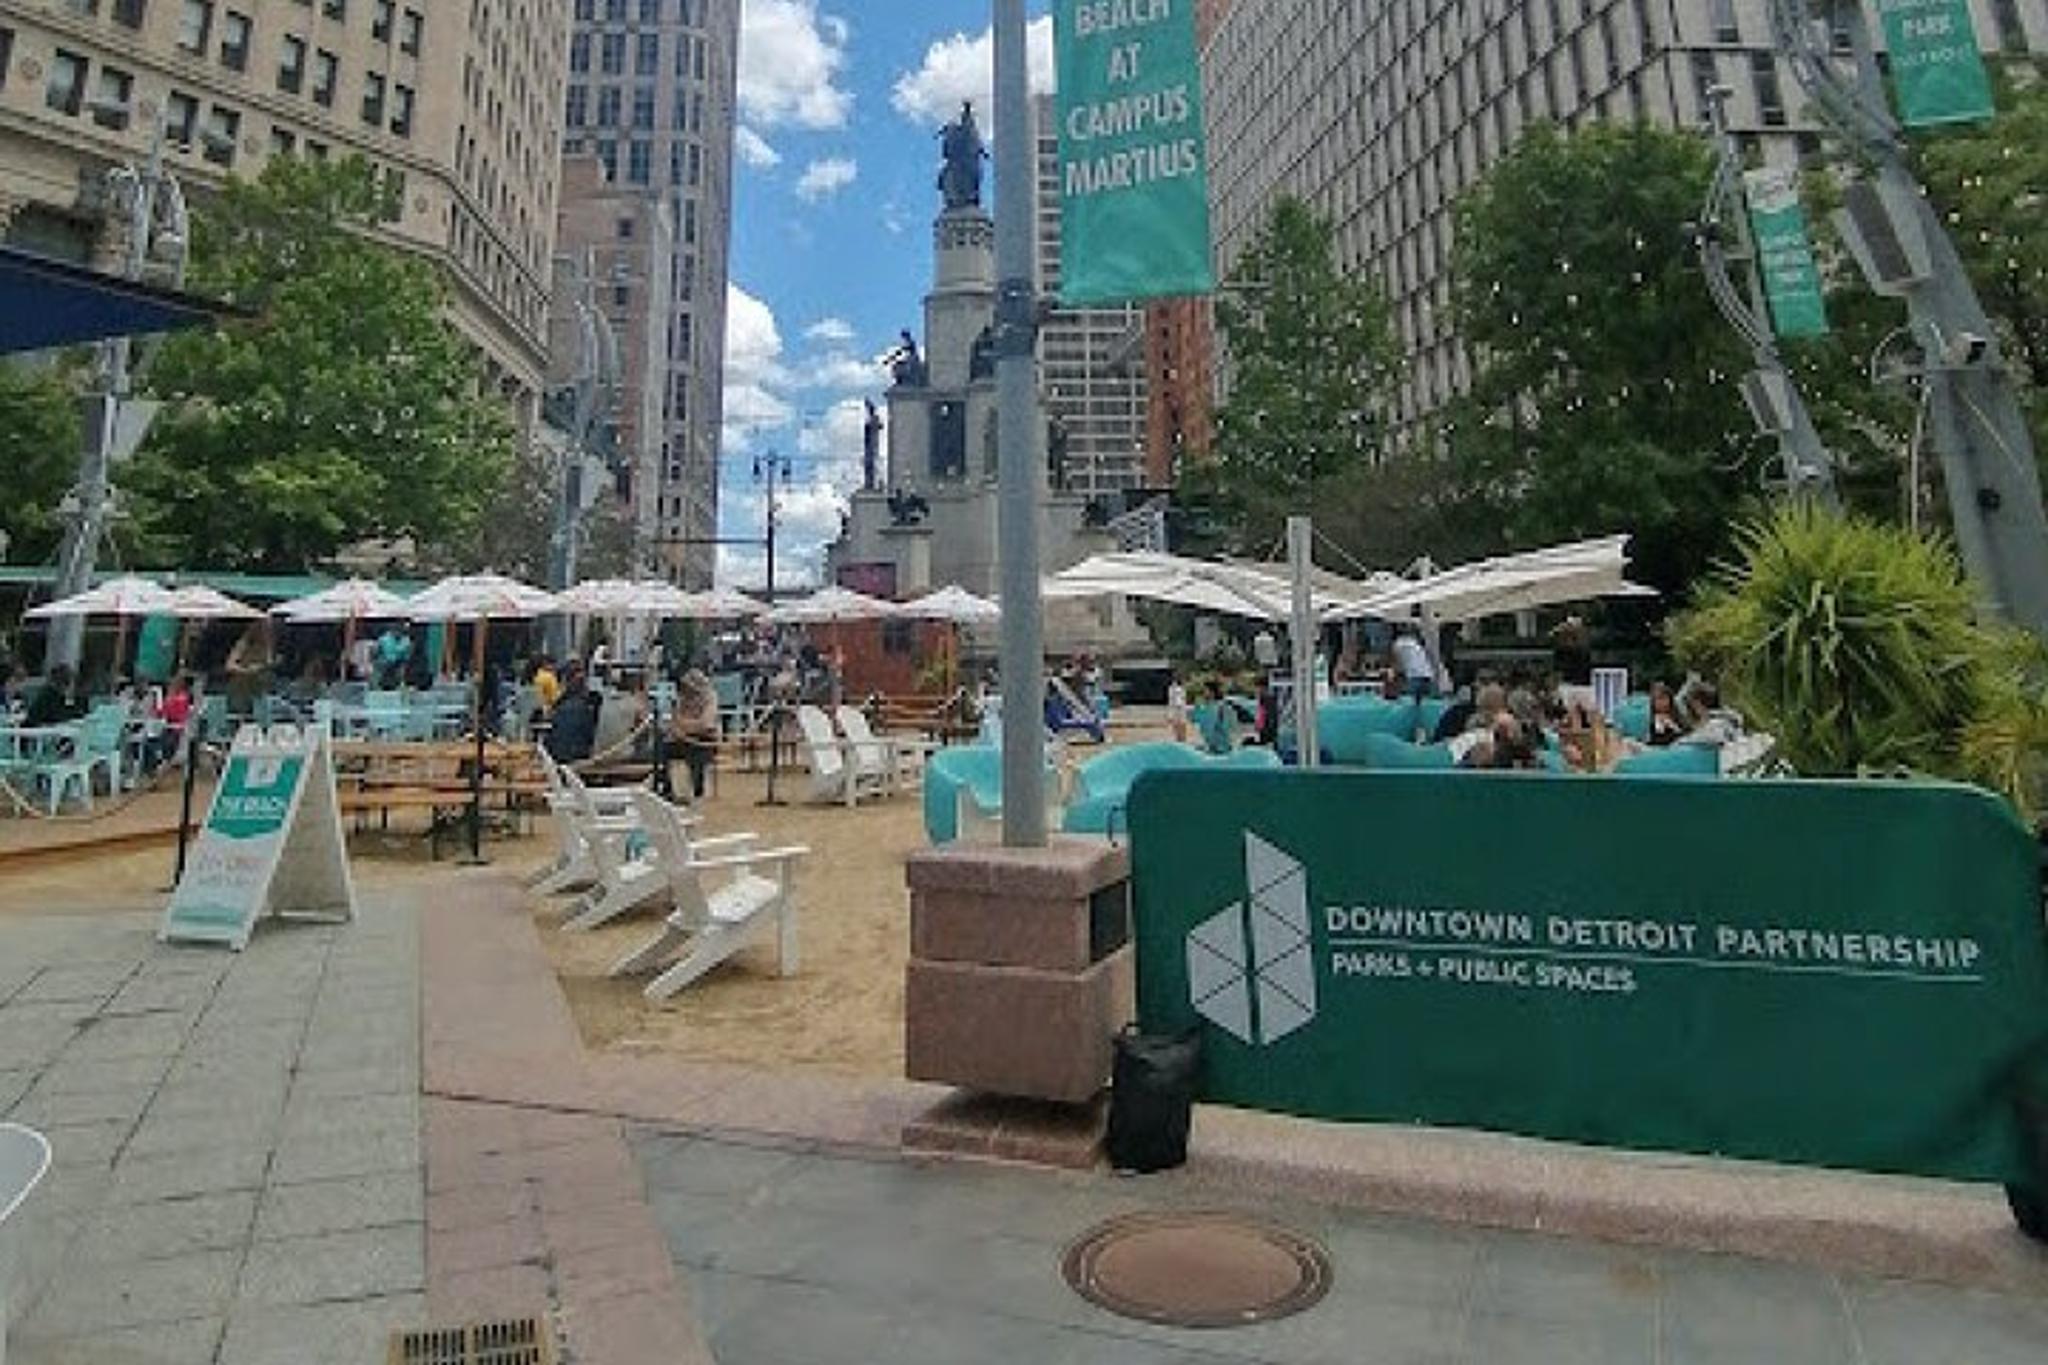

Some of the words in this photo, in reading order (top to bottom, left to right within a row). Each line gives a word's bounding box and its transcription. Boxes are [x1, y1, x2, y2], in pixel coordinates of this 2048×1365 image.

[1077, 0, 1169, 35] BEACH
[1109, 43, 1141, 81] AT
[1066, 84, 1188, 139] CAMPUS
[1066, 139, 1197, 197] MARTIUS
[1326, 905, 1533, 941] DOWNTOWN
[1547, 916, 1697, 949] DETROIT
[1716, 924, 1981, 968] PARTNERSHIP
[1332, 952, 1412, 977] PARKS
[1438, 957, 1531, 986] PUBLIC
[1536, 962, 1638, 991] SPACES
